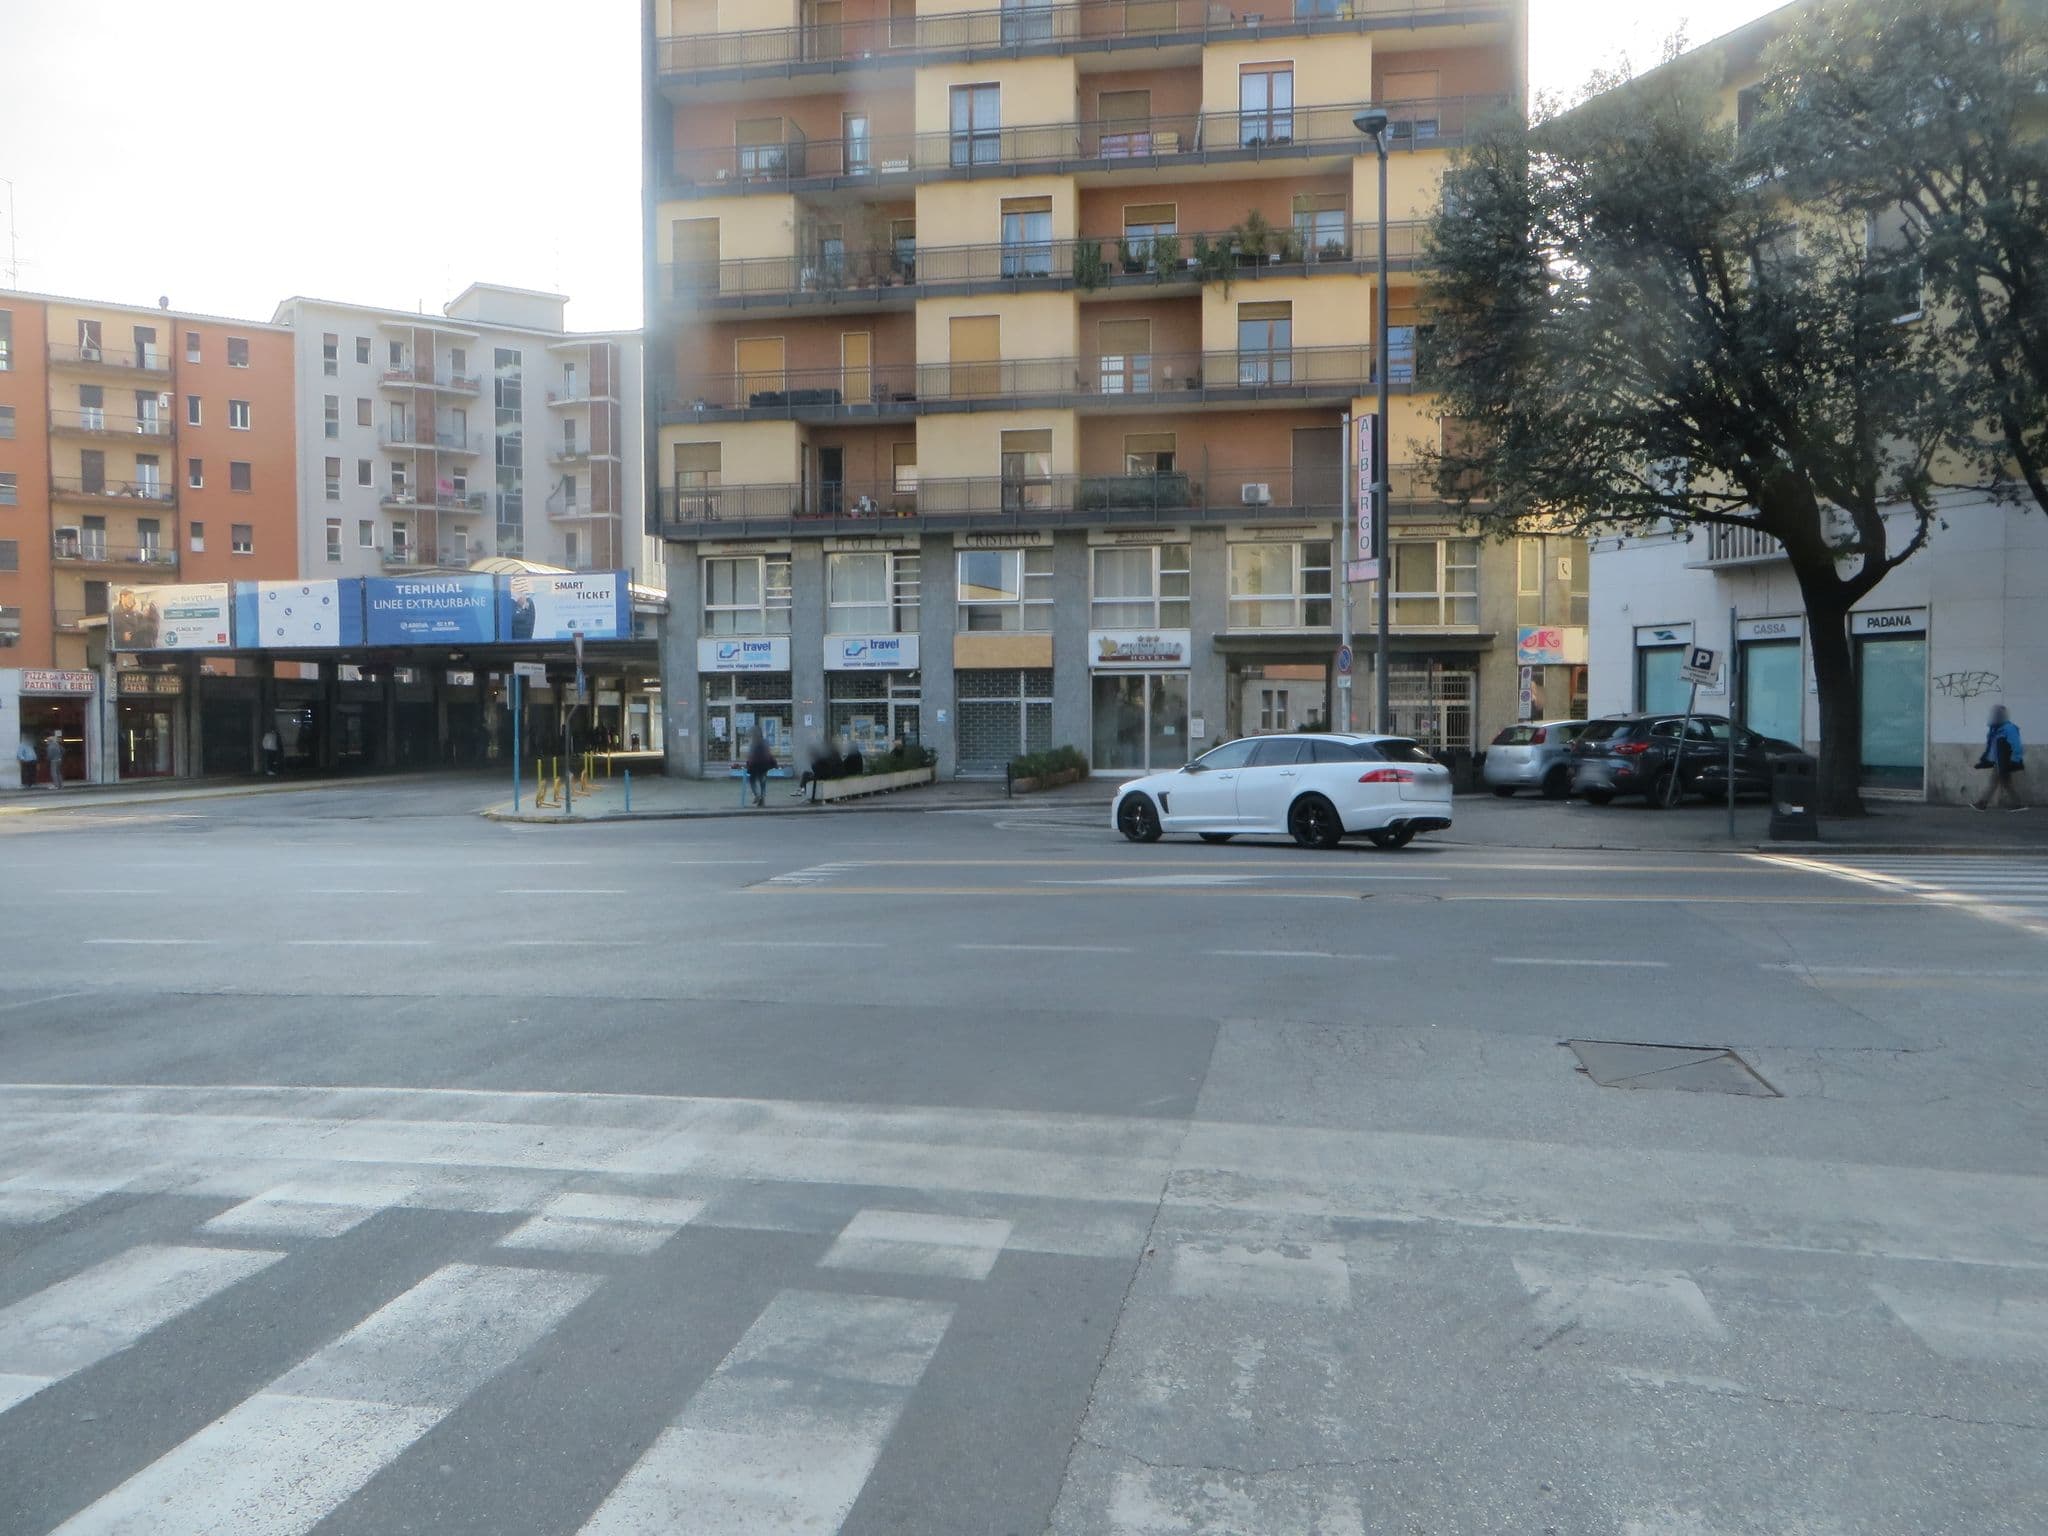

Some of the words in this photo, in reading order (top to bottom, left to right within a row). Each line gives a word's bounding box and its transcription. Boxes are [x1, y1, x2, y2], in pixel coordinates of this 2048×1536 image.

[1360, 418, 1370, 550] ALBERGO
[396, 584, 463, 595] TERMINAL
[554, 582, 584, 590] SMART
[576, 591, 610, 600] TICKET
[374, 600, 403, 610] LINEE
[406, 597, 486, 609] EXTRAURBANE
[1867, 615, 1913, 628] PADANA
[1753, 623, 1787, 634] CASSA
[743, 641, 771, 652] travel
[870, 639, 899, 650] travel
[24, 671, 48, 681] PIZZA
[60, 671, 94, 681] ASPORTO
[24, 681, 62, 690] PATATINE
[70, 681, 95, 691] BIBITE
